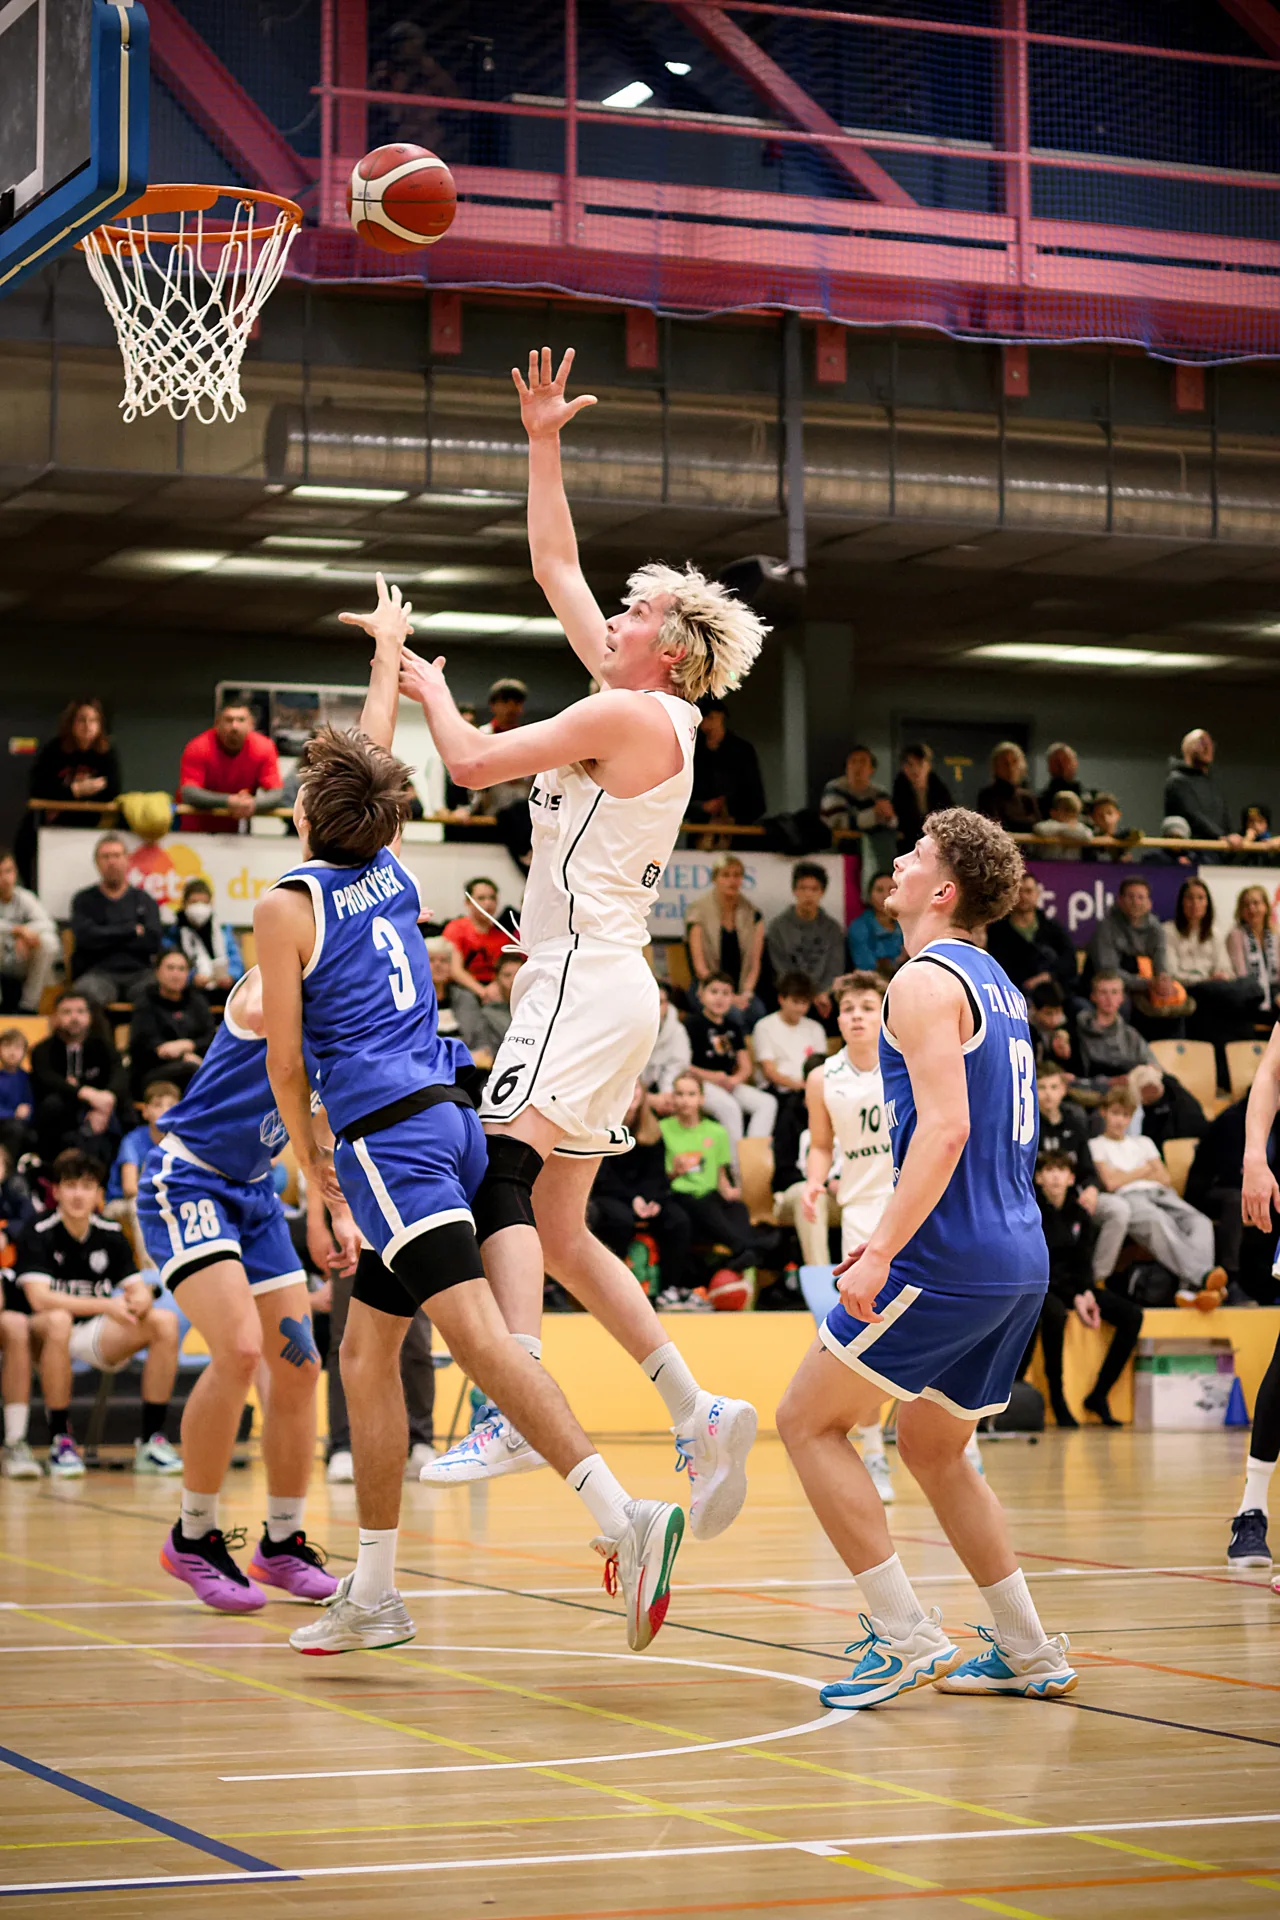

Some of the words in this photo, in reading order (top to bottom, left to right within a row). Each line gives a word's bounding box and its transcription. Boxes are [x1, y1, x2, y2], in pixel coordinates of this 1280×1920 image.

[332, 864, 405, 920] PROKÝŠEK
[372, 915, 417, 1011] 3
[508, 1035, 536, 1047] PRO
[491, 1063, 527, 1105] 6
[1009, 1036, 1035, 1146] 13
[859, 1104, 881, 1134] 10
[845, 1144, 890, 1160] WOLV
[180, 1198, 221, 1243] 28
